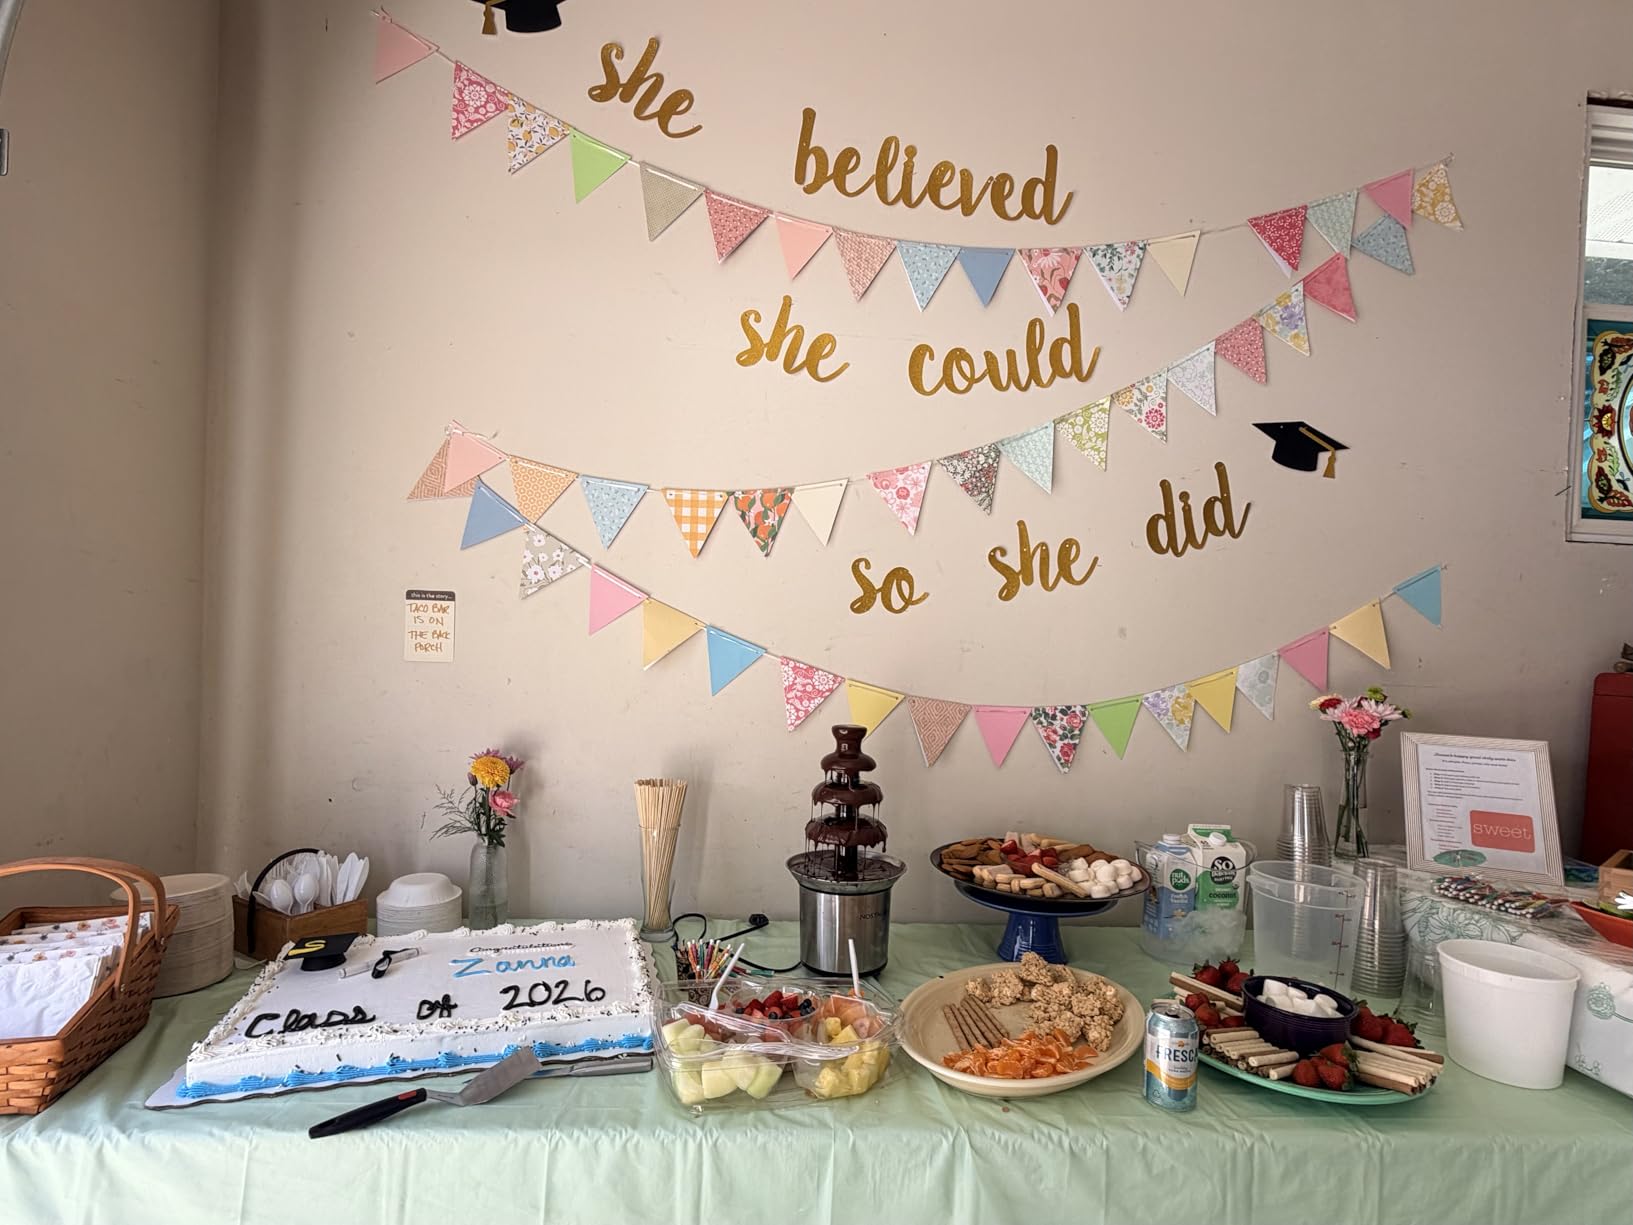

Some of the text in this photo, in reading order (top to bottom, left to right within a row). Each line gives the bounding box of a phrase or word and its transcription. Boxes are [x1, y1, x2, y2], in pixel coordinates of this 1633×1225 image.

[588, 37, 1073, 225] she believed
[736, 295, 1101, 397] she could
[850, 461, 1251, 614] so she did
[407, 603, 450, 614] TACO BAR
[414, 616, 444, 626] IS ON
[408, 630, 451, 640] THE BACK
[415, 642, 443, 653] PORCH
[1473, 823, 1532, 840] sweet
[1214, 859, 1233, 871] SO
[1172, 876, 1190, 885] pods
[288, 939, 326, 956] S
[450, 955, 576, 978] Zanna
[245, 979, 606, 1039] Class of 2026
